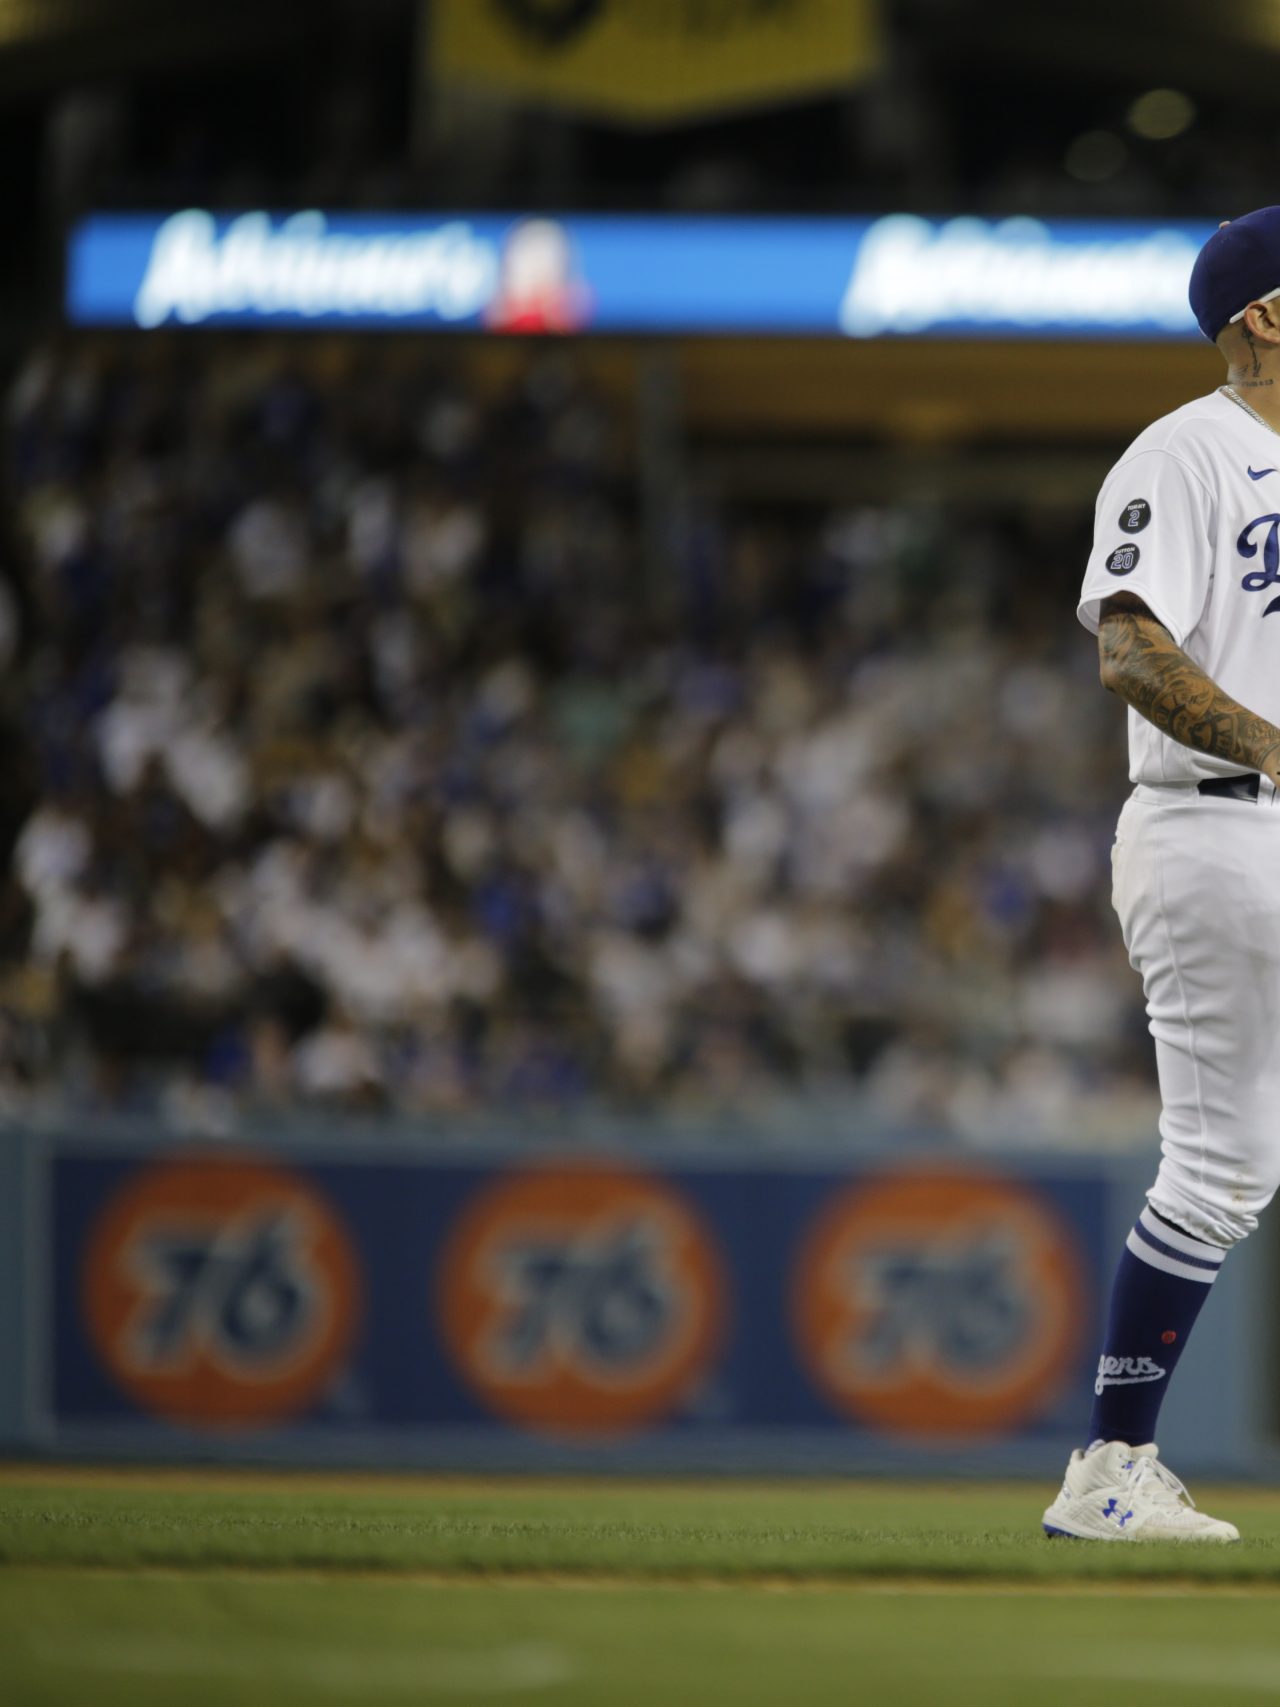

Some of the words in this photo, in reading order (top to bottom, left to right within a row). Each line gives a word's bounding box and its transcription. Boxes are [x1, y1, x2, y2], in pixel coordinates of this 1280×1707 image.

[1110, 552, 1134, 570] 20
[1127, 509, 1140, 527] 2
[122, 1192, 316, 1374] 76
[478, 1198, 678, 1382] 76
